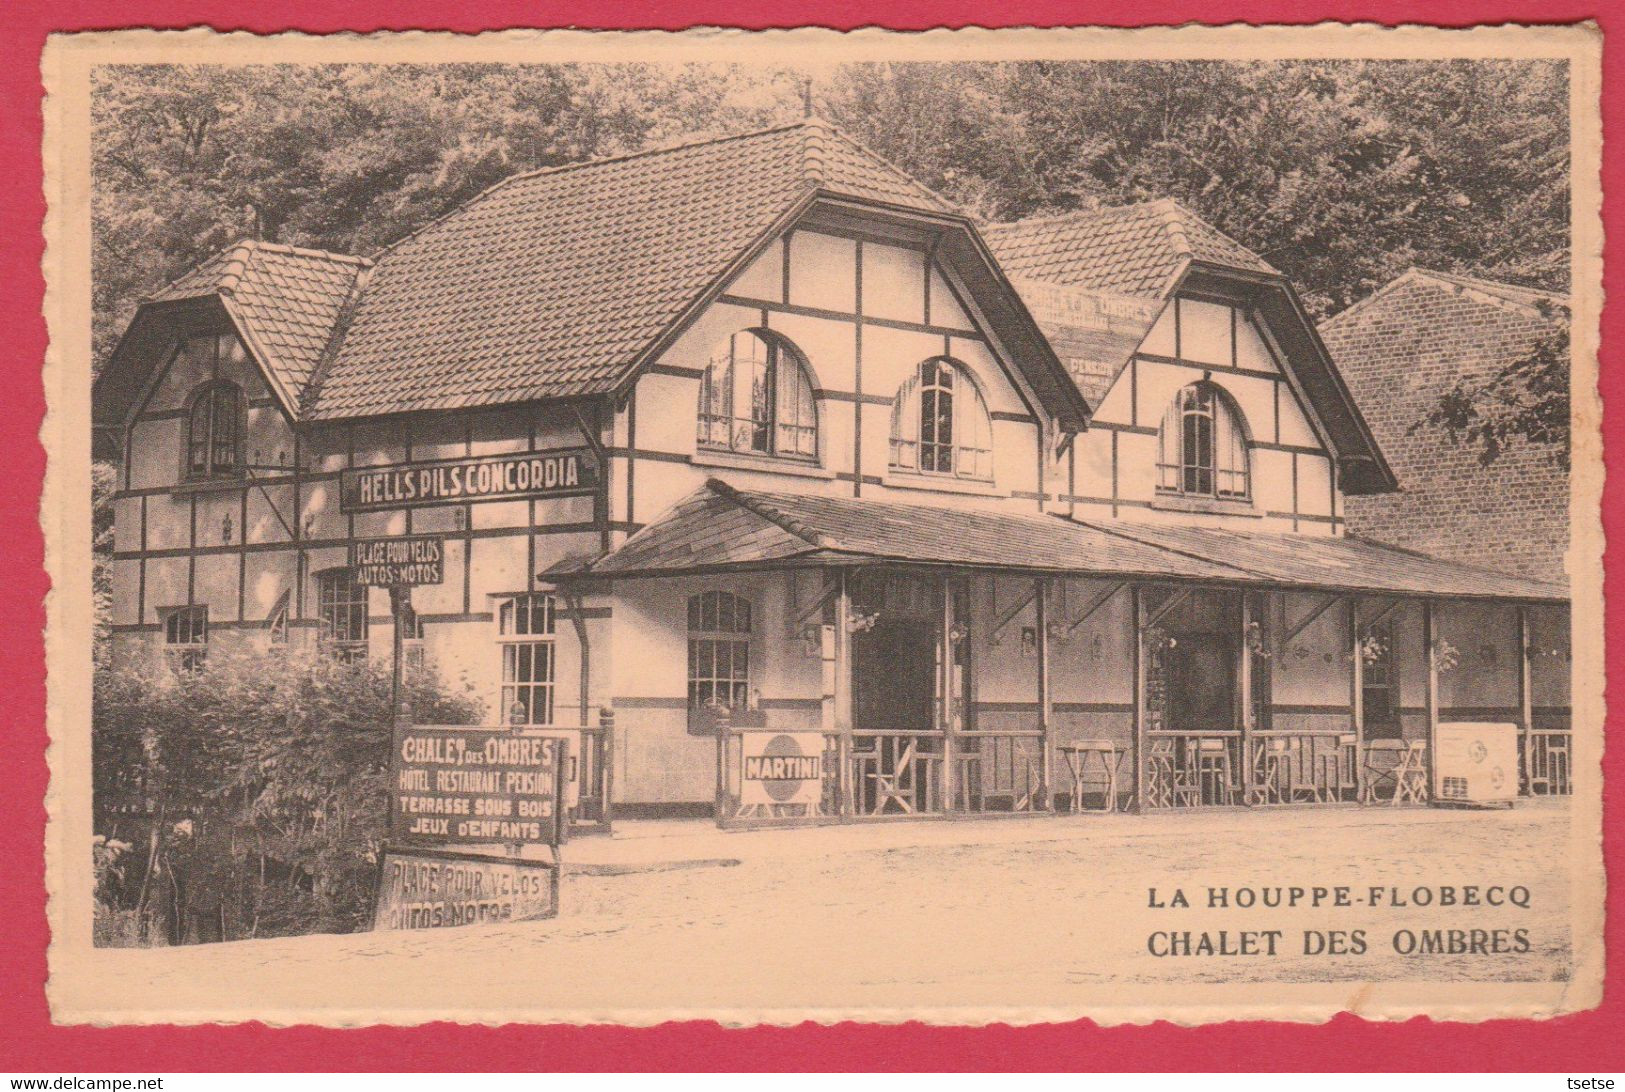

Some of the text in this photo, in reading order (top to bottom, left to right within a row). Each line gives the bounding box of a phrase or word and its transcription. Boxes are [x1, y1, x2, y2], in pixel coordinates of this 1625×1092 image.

[360, 457, 579, 503] HELLS PILS CONCORDIA
[387, 541, 409, 564] POUR
[411, 539, 440, 563] VELOS
[401, 736, 552, 766] CHALET DES OMBRES
[747, 757, 818, 779] MARTINI
[437, 770, 501, 793] RESTAURANT
[505, 771, 552, 795] PENSION
[400, 797, 552, 817] TERRASSE SOUS BOIS
[409, 818, 540, 839] JEUX D'ENFANTS
[445, 865, 483, 897] POUR
[491, 872, 540, 896] VELOS
